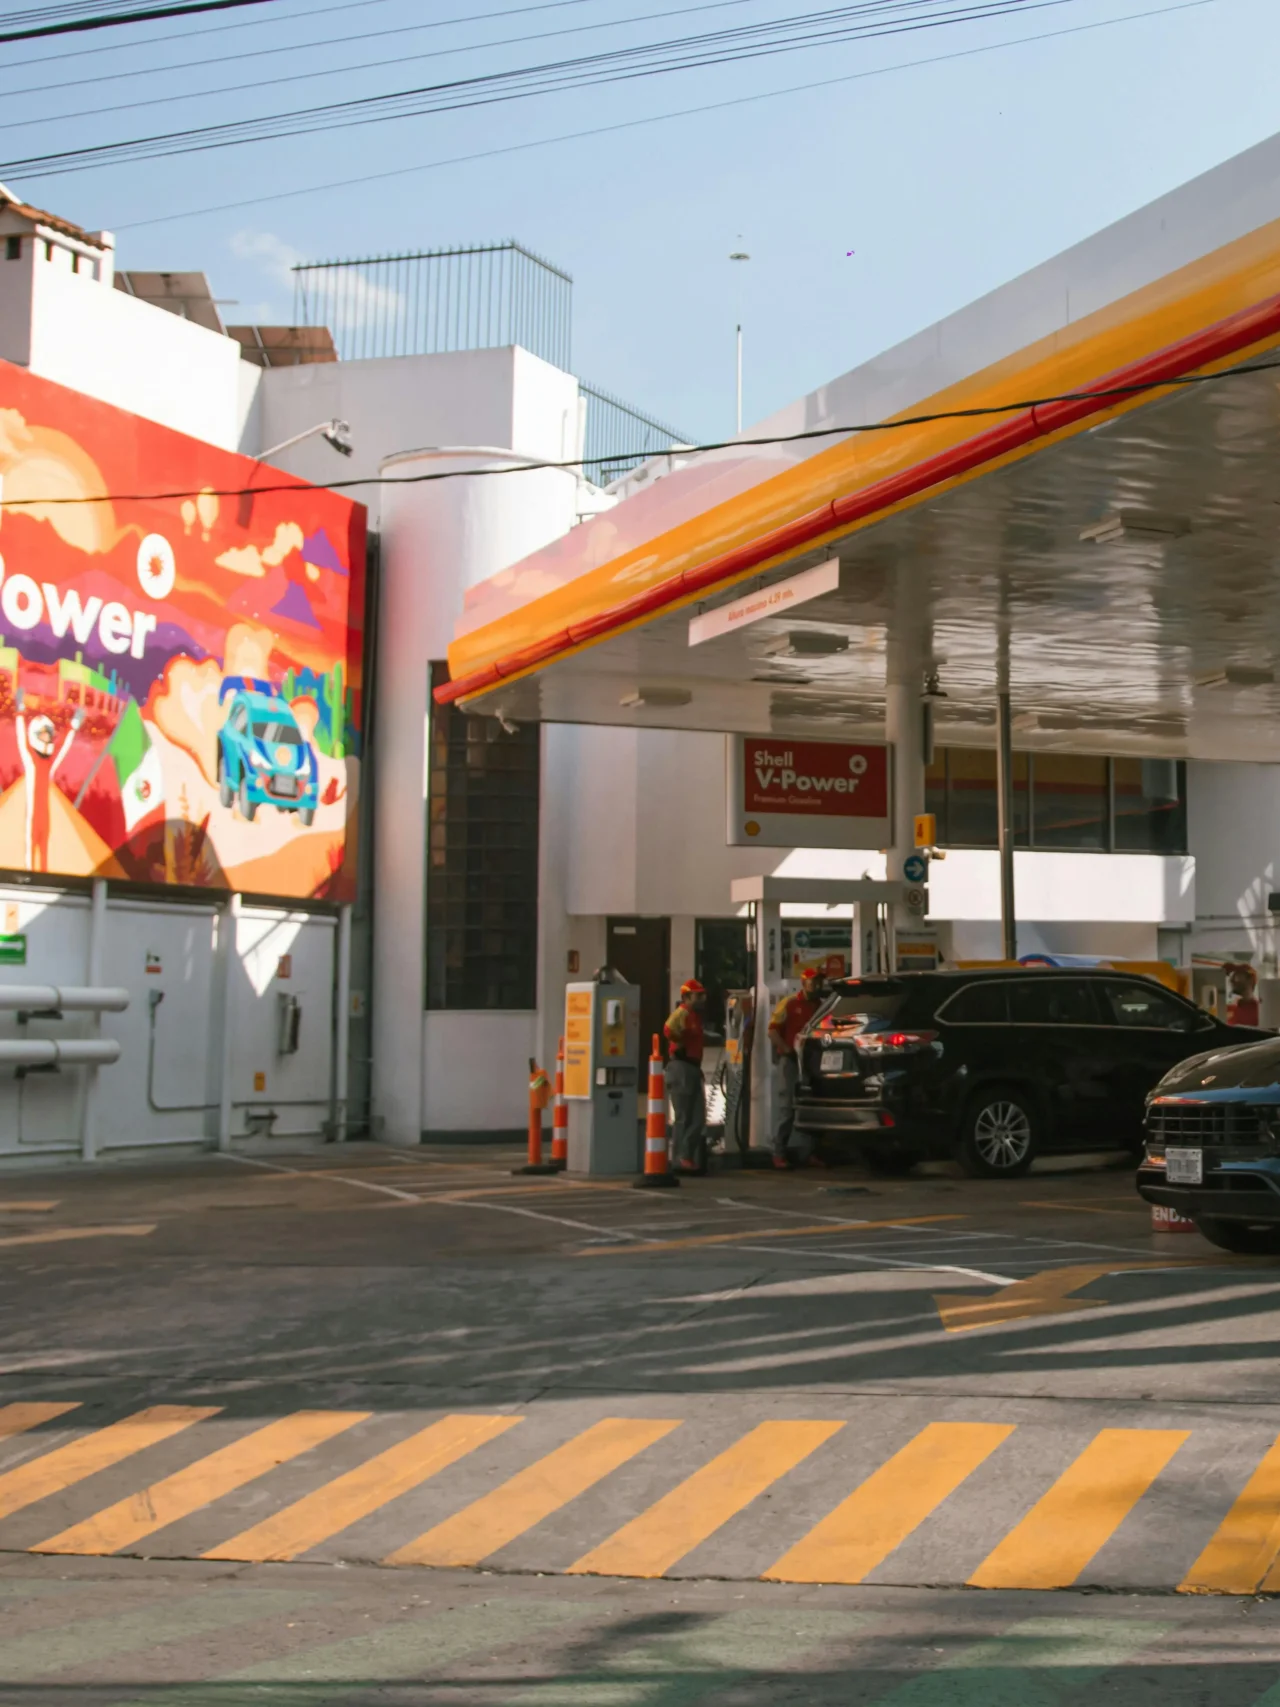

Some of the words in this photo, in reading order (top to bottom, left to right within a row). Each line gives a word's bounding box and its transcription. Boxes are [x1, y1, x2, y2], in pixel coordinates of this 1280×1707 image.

[0, 555, 157, 660] ower
[754, 750, 793, 767] Shell
[755, 768, 859, 793] V-Power
